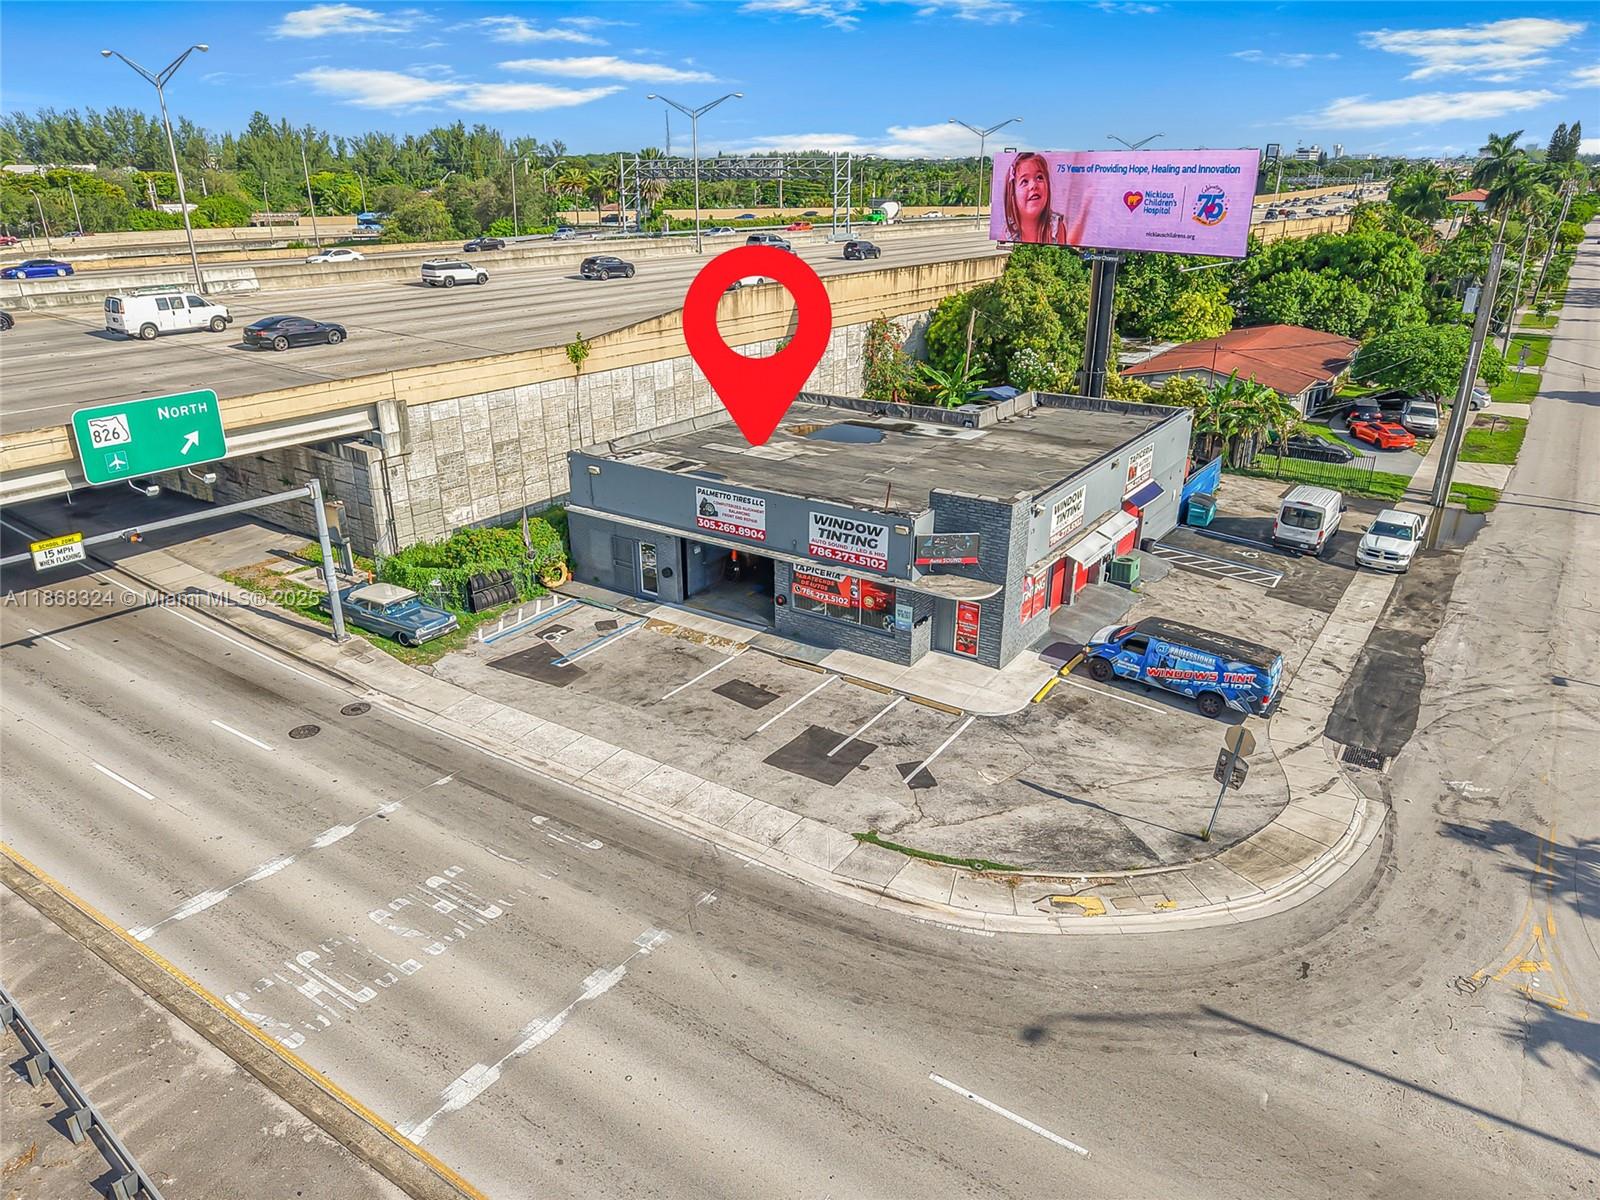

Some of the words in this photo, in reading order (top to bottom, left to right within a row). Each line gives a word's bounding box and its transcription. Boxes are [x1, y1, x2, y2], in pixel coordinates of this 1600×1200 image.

[1056, 164, 1066, 173] 75
[1066, 164, 1086, 173] Years
[1086, 164, 1094, 173] of
[1094, 164, 1128, 176] Providing
[1128, 164, 1150, 175] Hope,
[1151, 164, 1181, 176] Healing
[1181, 164, 1198, 174] and
[1198, 164, 1241, 174] Innovation
[1143, 206, 1171, 216] Hospital
[1197, 192, 1225, 219] 75
[157, 402, 208, 421] NORTH
[92, 427, 121, 444] 826
[697, 488, 732, 501] PALMETTO
[732, 494, 752, 505] TIRES
[752, 499, 765, 507] LLC
[1054, 487, 1085, 515] WINDOW
[1056, 500, 1083, 526] TINTING
[697, 517, 765, 541] 305.269.8904
[813, 514, 884, 537] WINDOW
[38, 540, 60, 550] SCHOOL
[810, 537, 827, 546] AUTO
[827, 540, 849, 551] SOUND
[856, 547, 868, 555] LED
[818, 527, 879, 550] TINTING
[38, 559, 56, 568] WHEN
[55, 551, 82, 564] FLASHING
[44, 549, 55, 559] 15
[56, 546, 74, 556] MPH
[810, 545, 886, 570] 786.273.5102
[1168, 646, 1217, 665] PROFESSIONAL
[1146, 666, 1219, 682] WINDOWS
[1222, 672, 1257, 684] TINT
